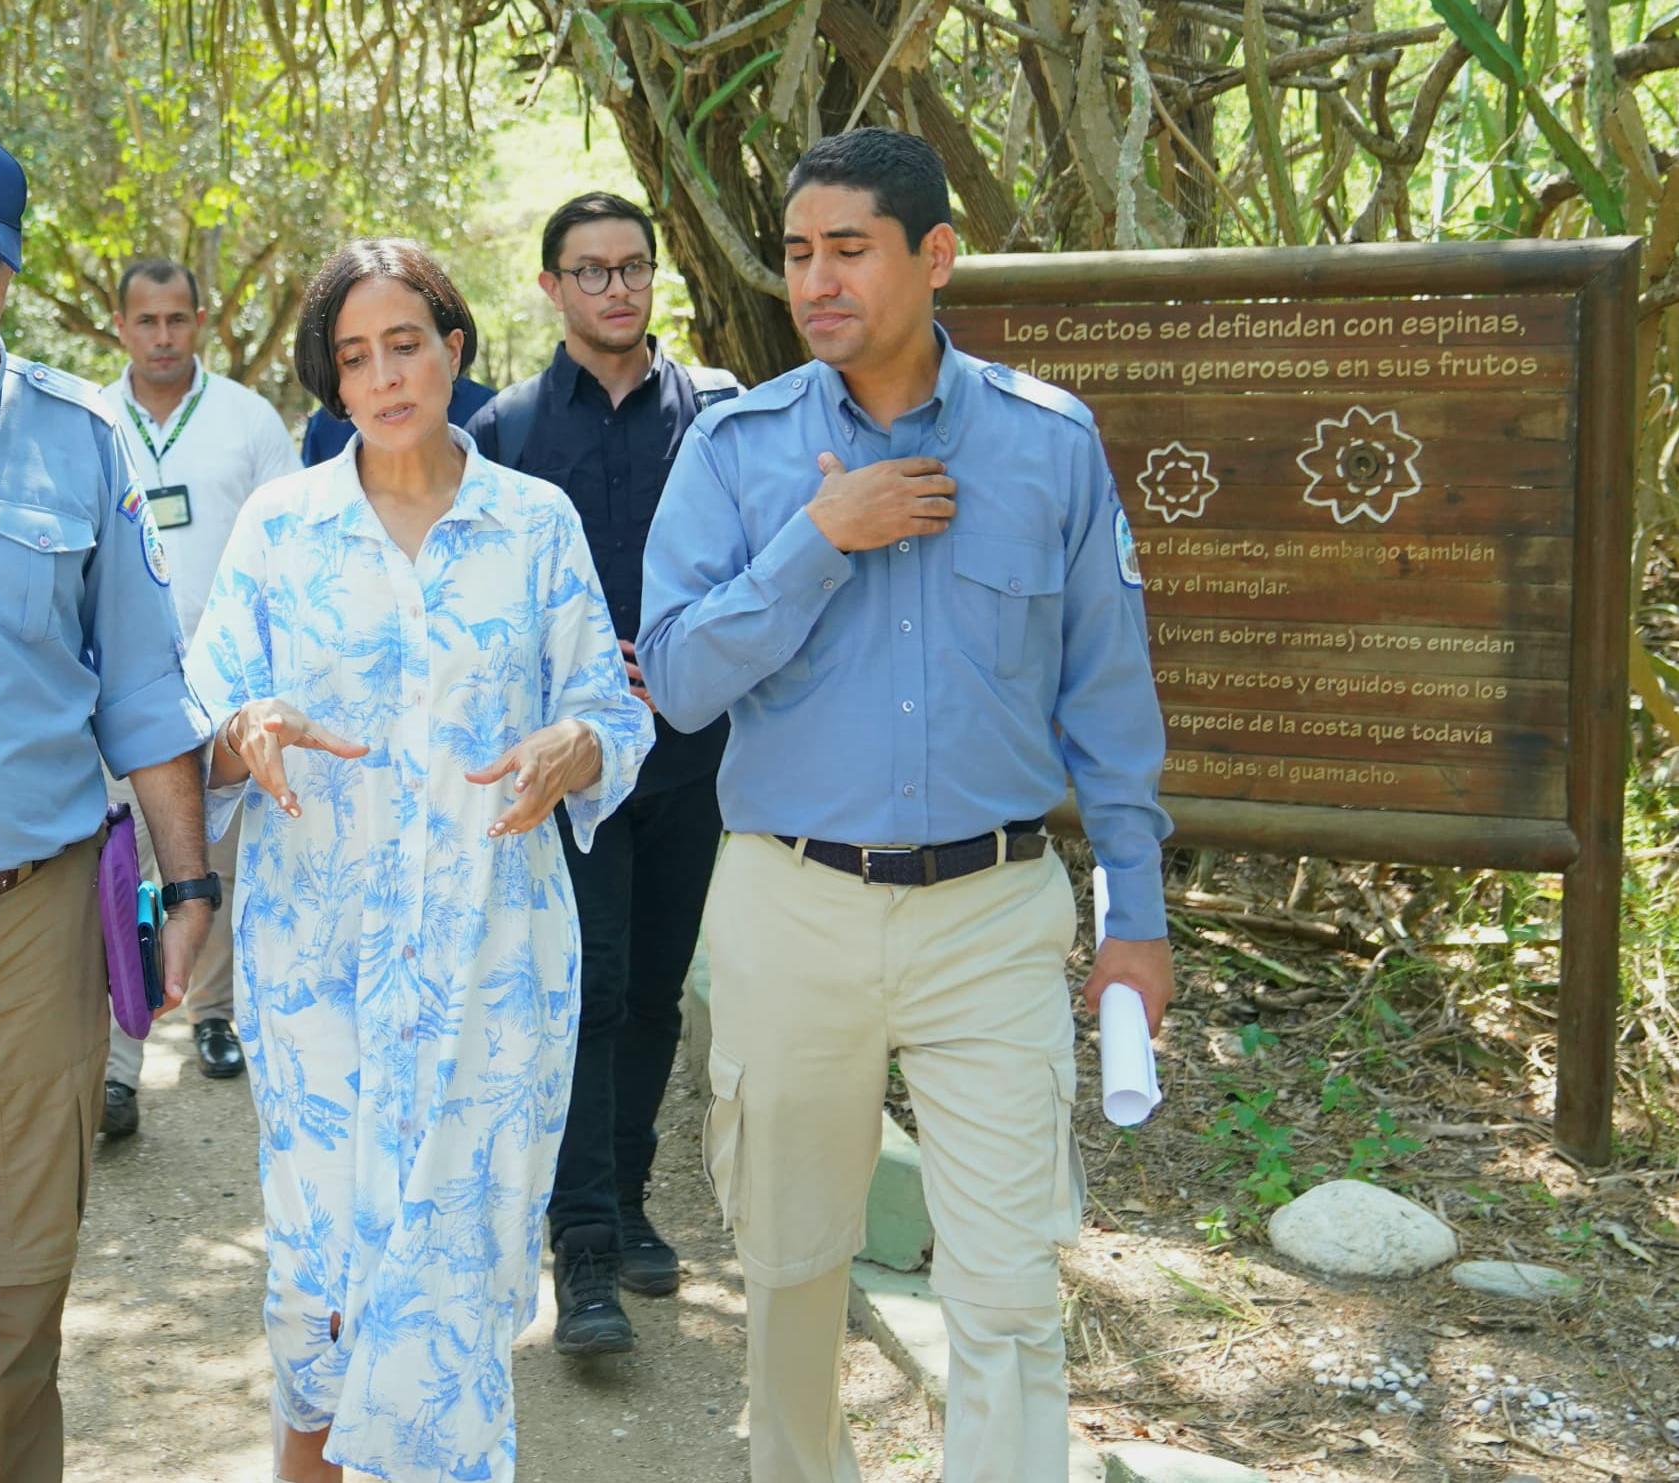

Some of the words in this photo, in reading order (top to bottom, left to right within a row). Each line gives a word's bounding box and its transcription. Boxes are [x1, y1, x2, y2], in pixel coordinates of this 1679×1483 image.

[1004, 318, 1049, 342] Los
[1055, 317, 1152, 341] Cactos
[1160, 320, 1191, 340] se
[1197, 312, 1336, 339] defienden
[1344, 317, 1393, 337] con
[1401, 310, 1526, 344] espinas,
[1126, 360, 1174, 380] son
[1182, 359, 1329, 385] generosos
[1337, 359, 1369, 378] en
[1377, 357, 1431, 377] sus
[1437, 351, 1538, 377] frutos
[1157, 537, 1172, 555] el
[1178, 538, 1269, 559] desierto,
[1275, 540, 1303, 557] sin
[1309, 541, 1400, 565] embargo
[1405, 542, 1495, 561] también
[1167, 578, 1180, 596] y
[1184, 575, 1200, 592] el
[1206, 577, 1291, 599] manglar.
[1158, 622, 1214, 645] (viven
[1219, 625, 1277, 644] sobre
[1281, 629, 1355, 652] ramas)
[1361, 633, 1421, 650] otros
[1427, 635, 1515, 654] enredan
[1153, 670, 1180, 684] os
[1186, 667, 1220, 690] hay
[1225, 671, 1294, 689] rectos
[1296, 677, 1311, 694] y
[1315, 675, 1406, 696] erguidos
[1411, 682, 1469, 697] como
[1475, 680, 1508, 700] los
[1169, 713, 1244, 735] especie
[1248, 715, 1273, 732] de
[1279, 715, 1296, 733] la
[1301, 719, 1362, 737] costa
[1368, 723, 1405, 744] que
[1412, 722, 1493, 744] todavía
[1164, 757, 1198, 773] sus
[1203, 755, 1262, 780] hojas:
[1268, 760, 1284, 778] el
[1289, 765, 1399, 784] guamacho.
